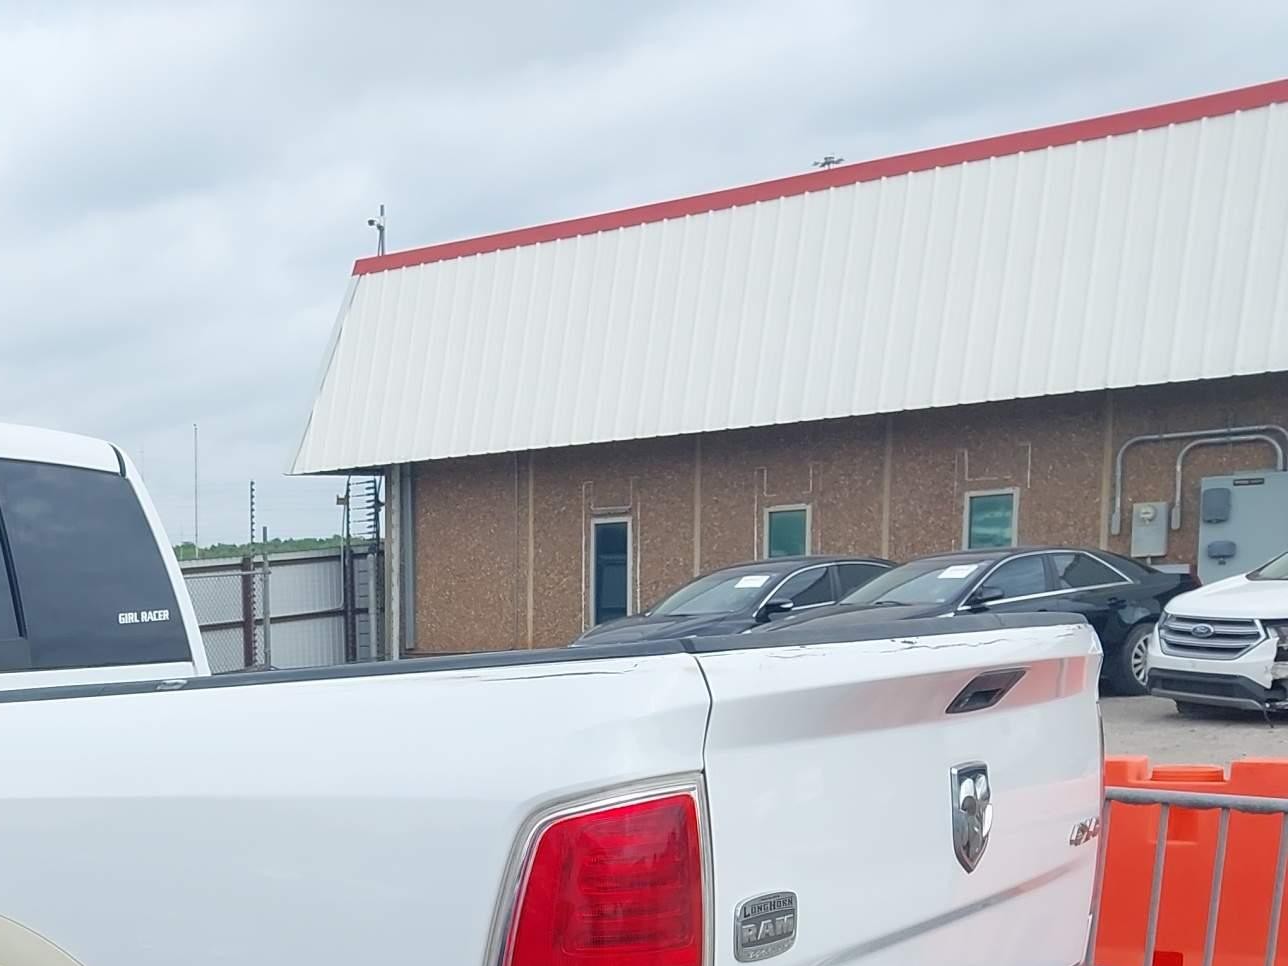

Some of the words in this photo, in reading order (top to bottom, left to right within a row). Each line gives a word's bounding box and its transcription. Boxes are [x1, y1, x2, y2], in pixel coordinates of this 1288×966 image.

[118, 612, 140, 624] GIRL
[141, 609, 170, 622] RACER
[742, 914, 794, 943] RAM
